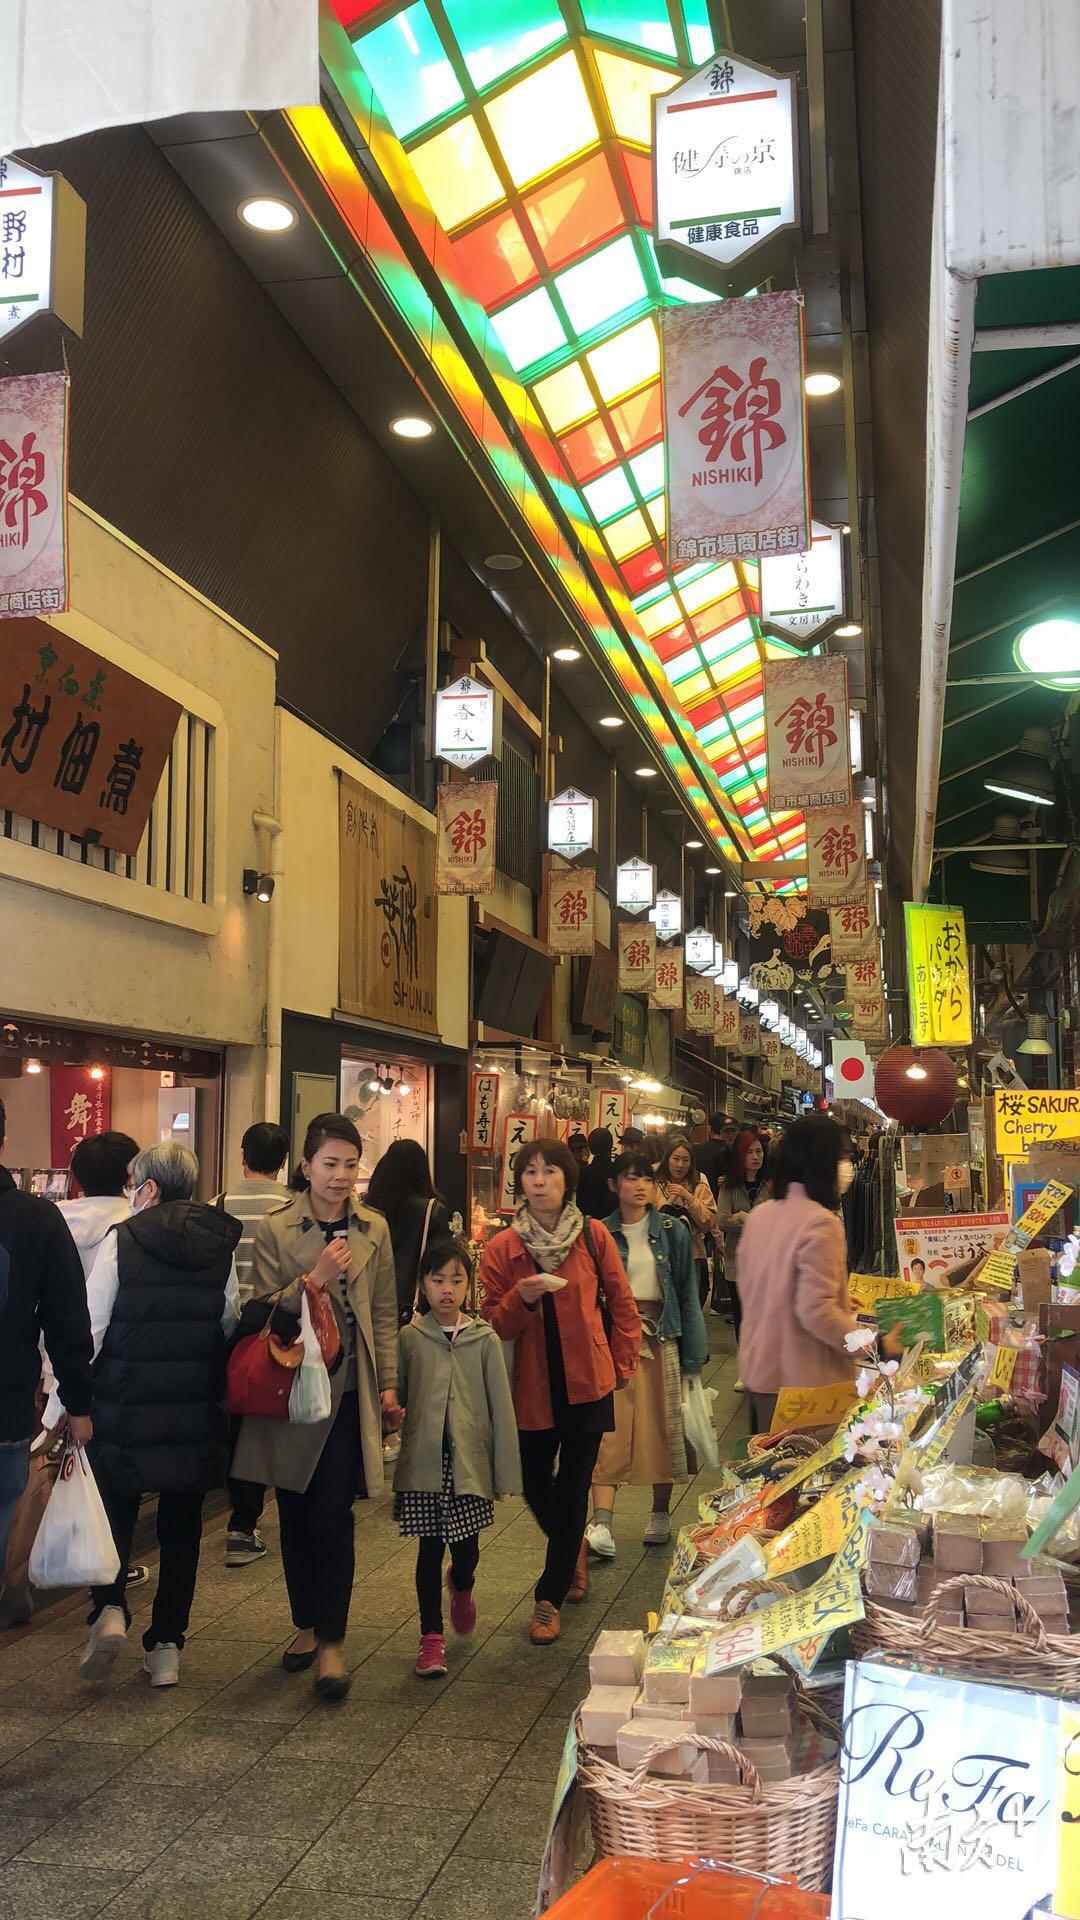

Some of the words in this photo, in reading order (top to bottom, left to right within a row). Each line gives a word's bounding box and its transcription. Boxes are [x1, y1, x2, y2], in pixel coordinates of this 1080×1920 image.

[705, 61, 735, 93] 錦
[687, 218, 760, 244] 健康食品
[678, 356, 787, 488] 錦
[692, 466, 752, 488] NISHIKI
[677, 525, 800, 560] 錦市場商店街
[453, 703, 475, 742] 春秋
[774, 692, 838, 769] 錦
[451, 753, 476, 761] のれん
[782, 757, 818, 768] NISHIKI
[775, 791, 846, 808] 錦市場商店街
[445, 809, 487, 865] 錦
[813, 824, 858, 877] 錦
[448, 855, 473, 864] NISHIKI
[818, 868, 844, 878] NISHIKI
[553, 890, 588, 931] 錦
[623, 939, 650, 973] 錦
[942, 921, 964, 1021] おから
[392, 980, 434, 1016] SHUNJU
[690, 989, 711, 1015] 錦
[916, 963, 929, 1038] あります
[476, 1078, 492, 1145] はも寿司
[997, 1093, 1026, 1116] 桜
[1027, 1096, 1080, 1114] SAKUR
[1003, 1119, 1058, 1139] Cherry
[906, 1239, 916, 1255] 国産
[941, 1241, 990, 1259] ごぼう茶
